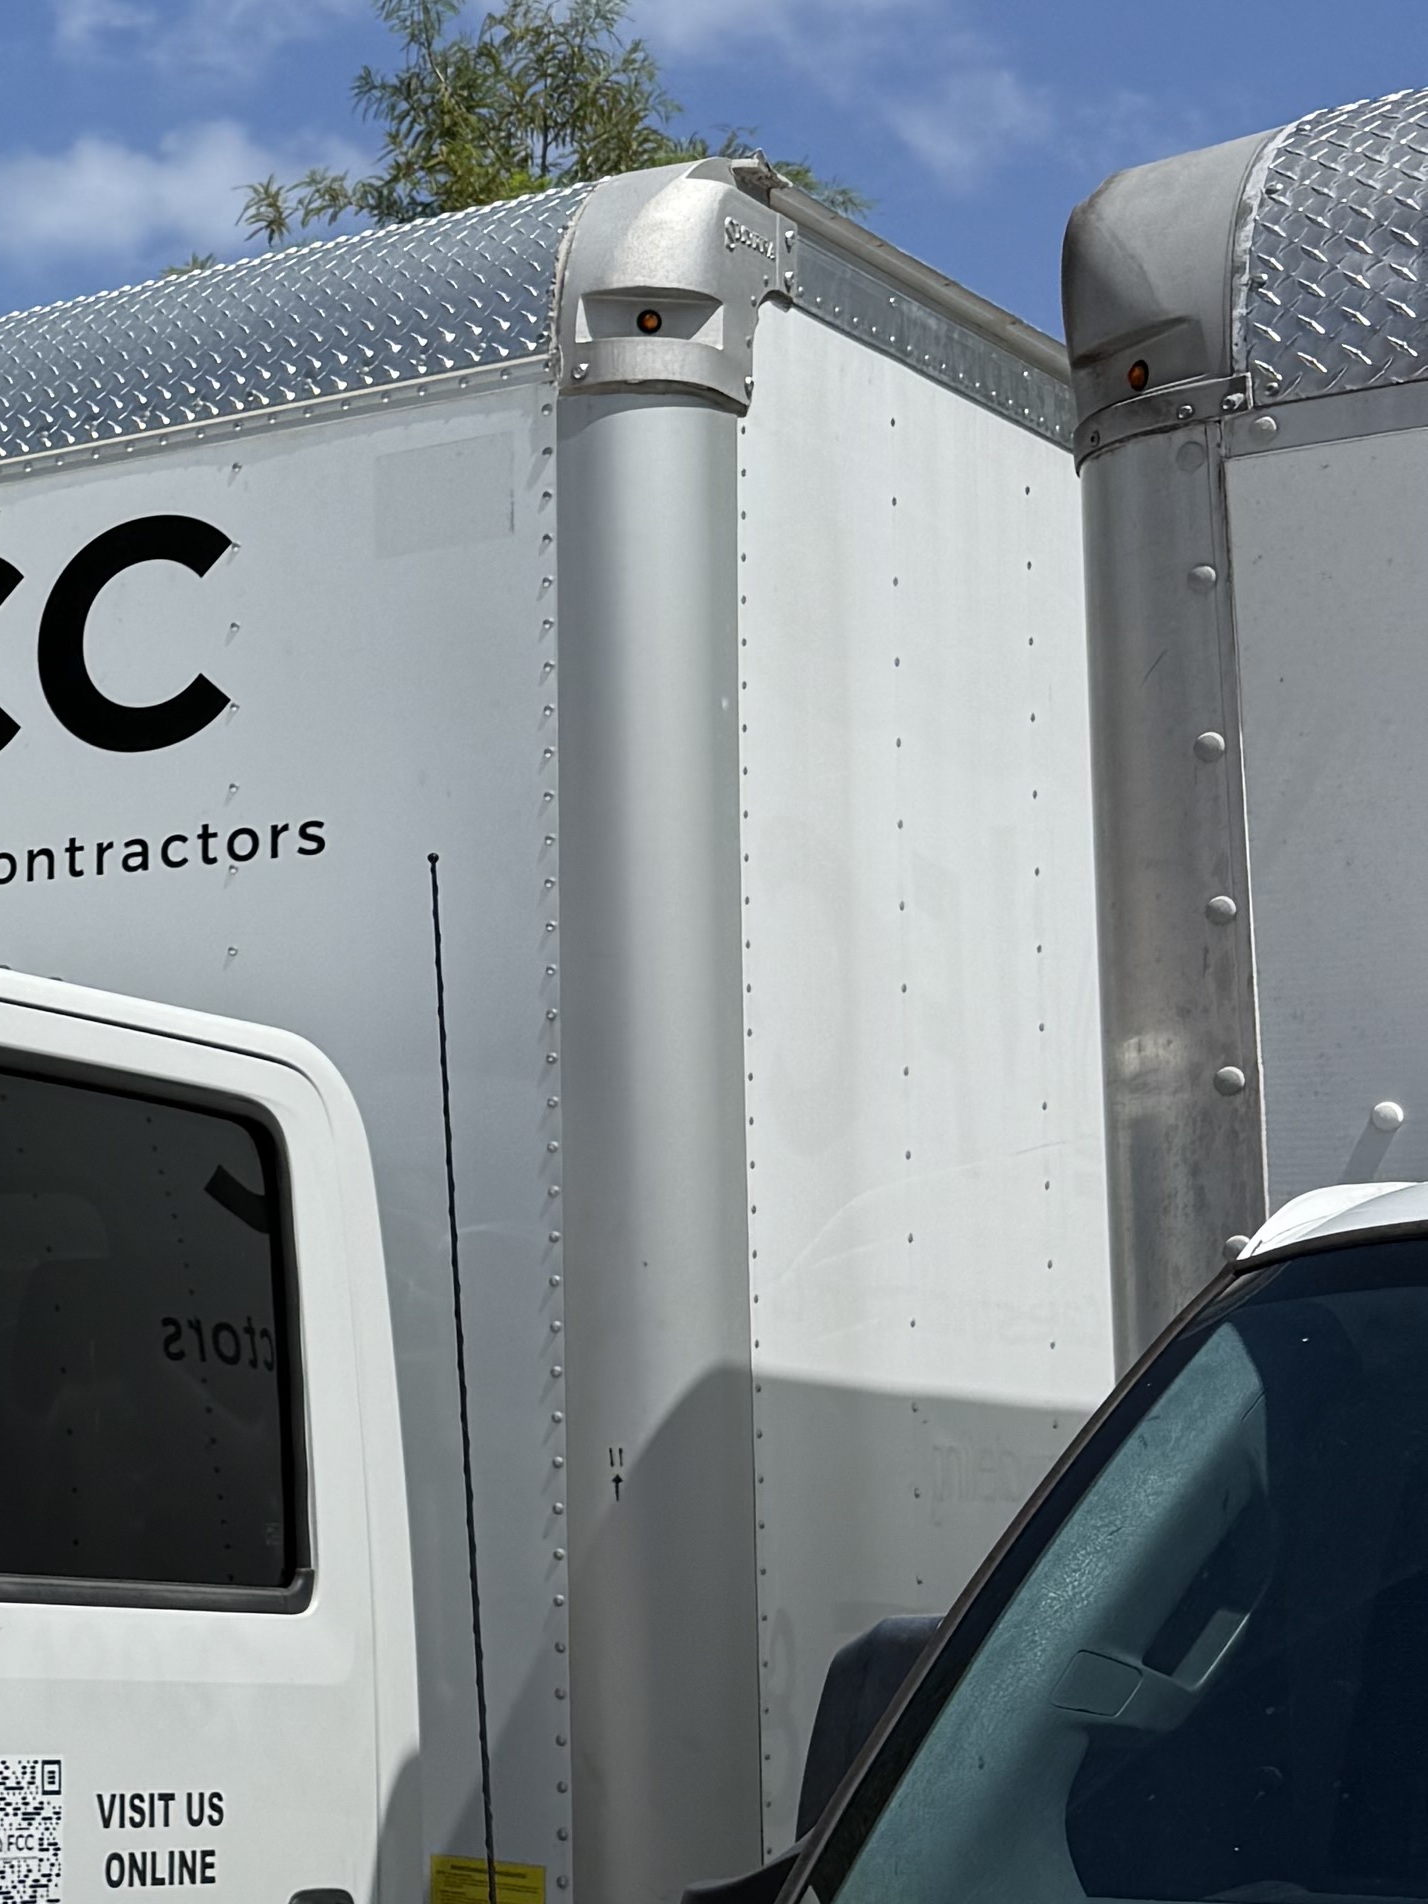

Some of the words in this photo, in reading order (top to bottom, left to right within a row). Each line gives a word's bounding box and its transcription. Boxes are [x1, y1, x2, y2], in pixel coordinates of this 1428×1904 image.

[96, 1792, 174, 1829] VISIT
[186, 1791, 225, 1827] US
[6, 1833, 35, 1851] FCC
[104, 1849, 217, 1888] ONLINE
